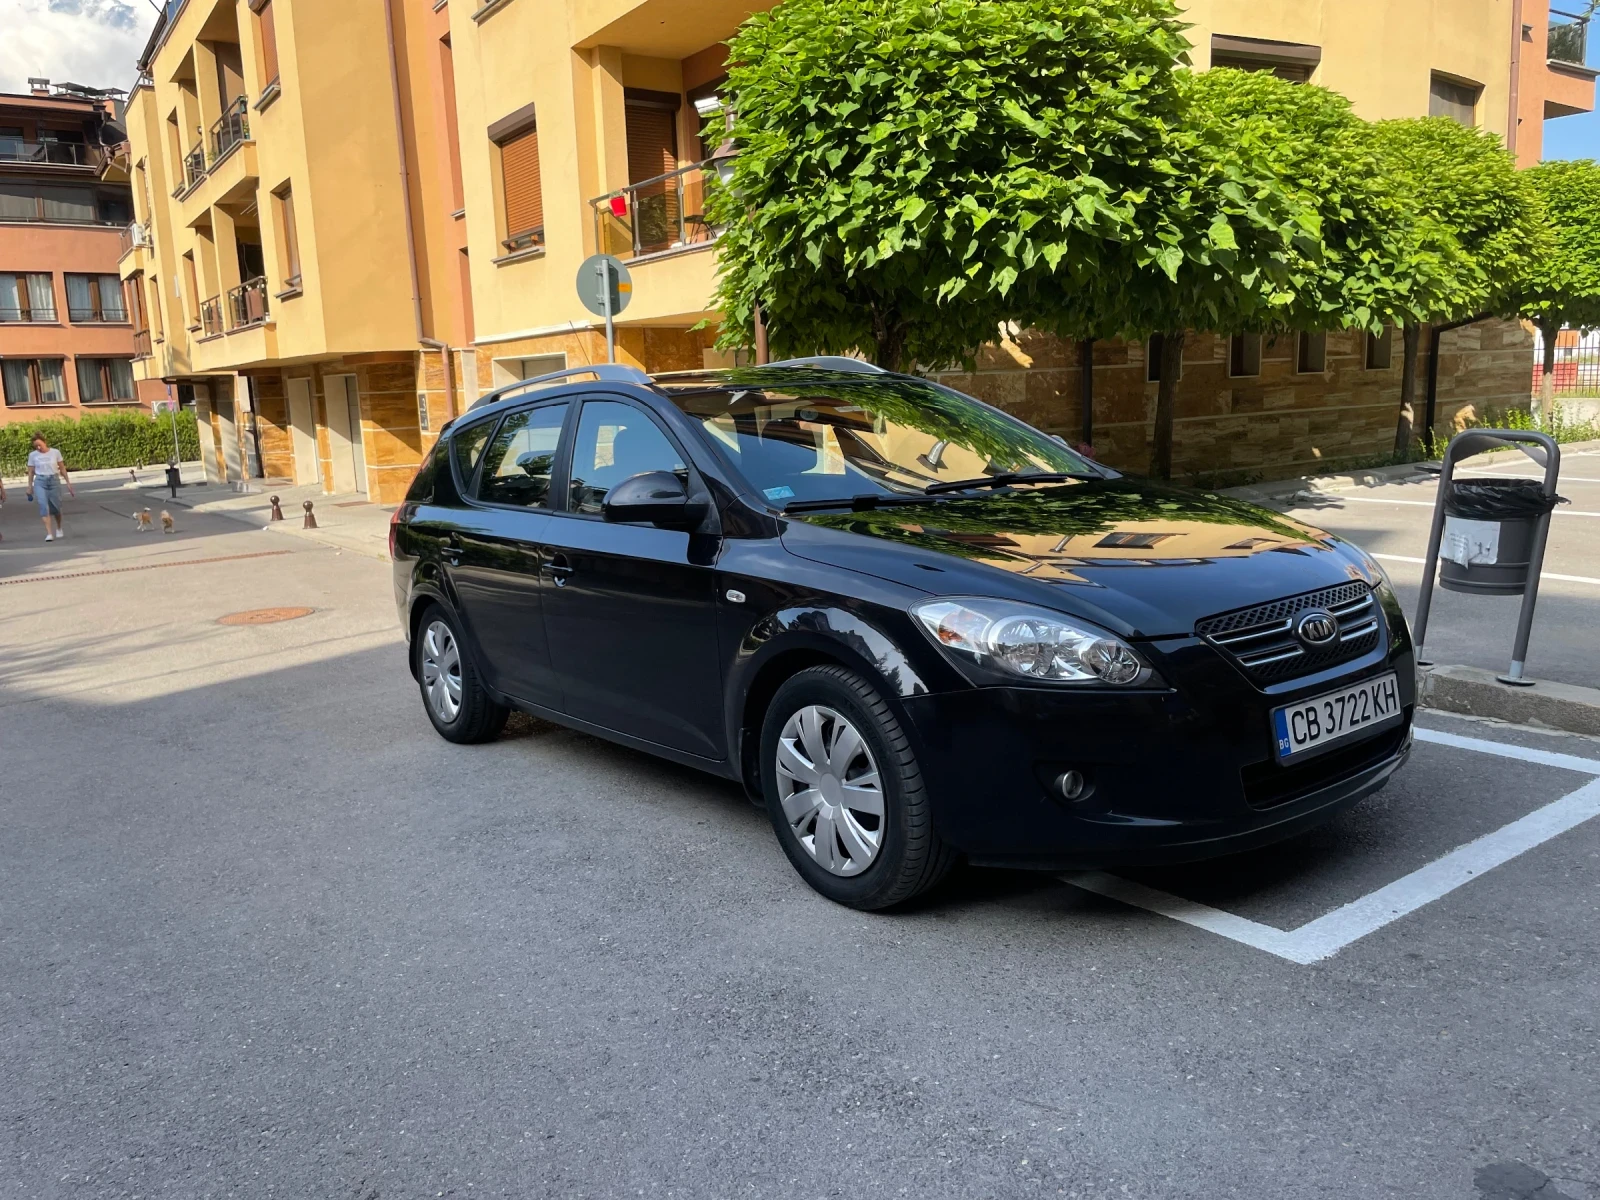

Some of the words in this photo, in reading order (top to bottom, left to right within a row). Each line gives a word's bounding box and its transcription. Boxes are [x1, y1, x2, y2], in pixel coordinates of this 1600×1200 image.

[1304, 619, 1334, 640] KIA
[1291, 706, 1321, 745] CB
[1324, 689, 1371, 734] 3722
[1371, 679, 1397, 717] KH
[1279, 738, 1290, 750] BG
